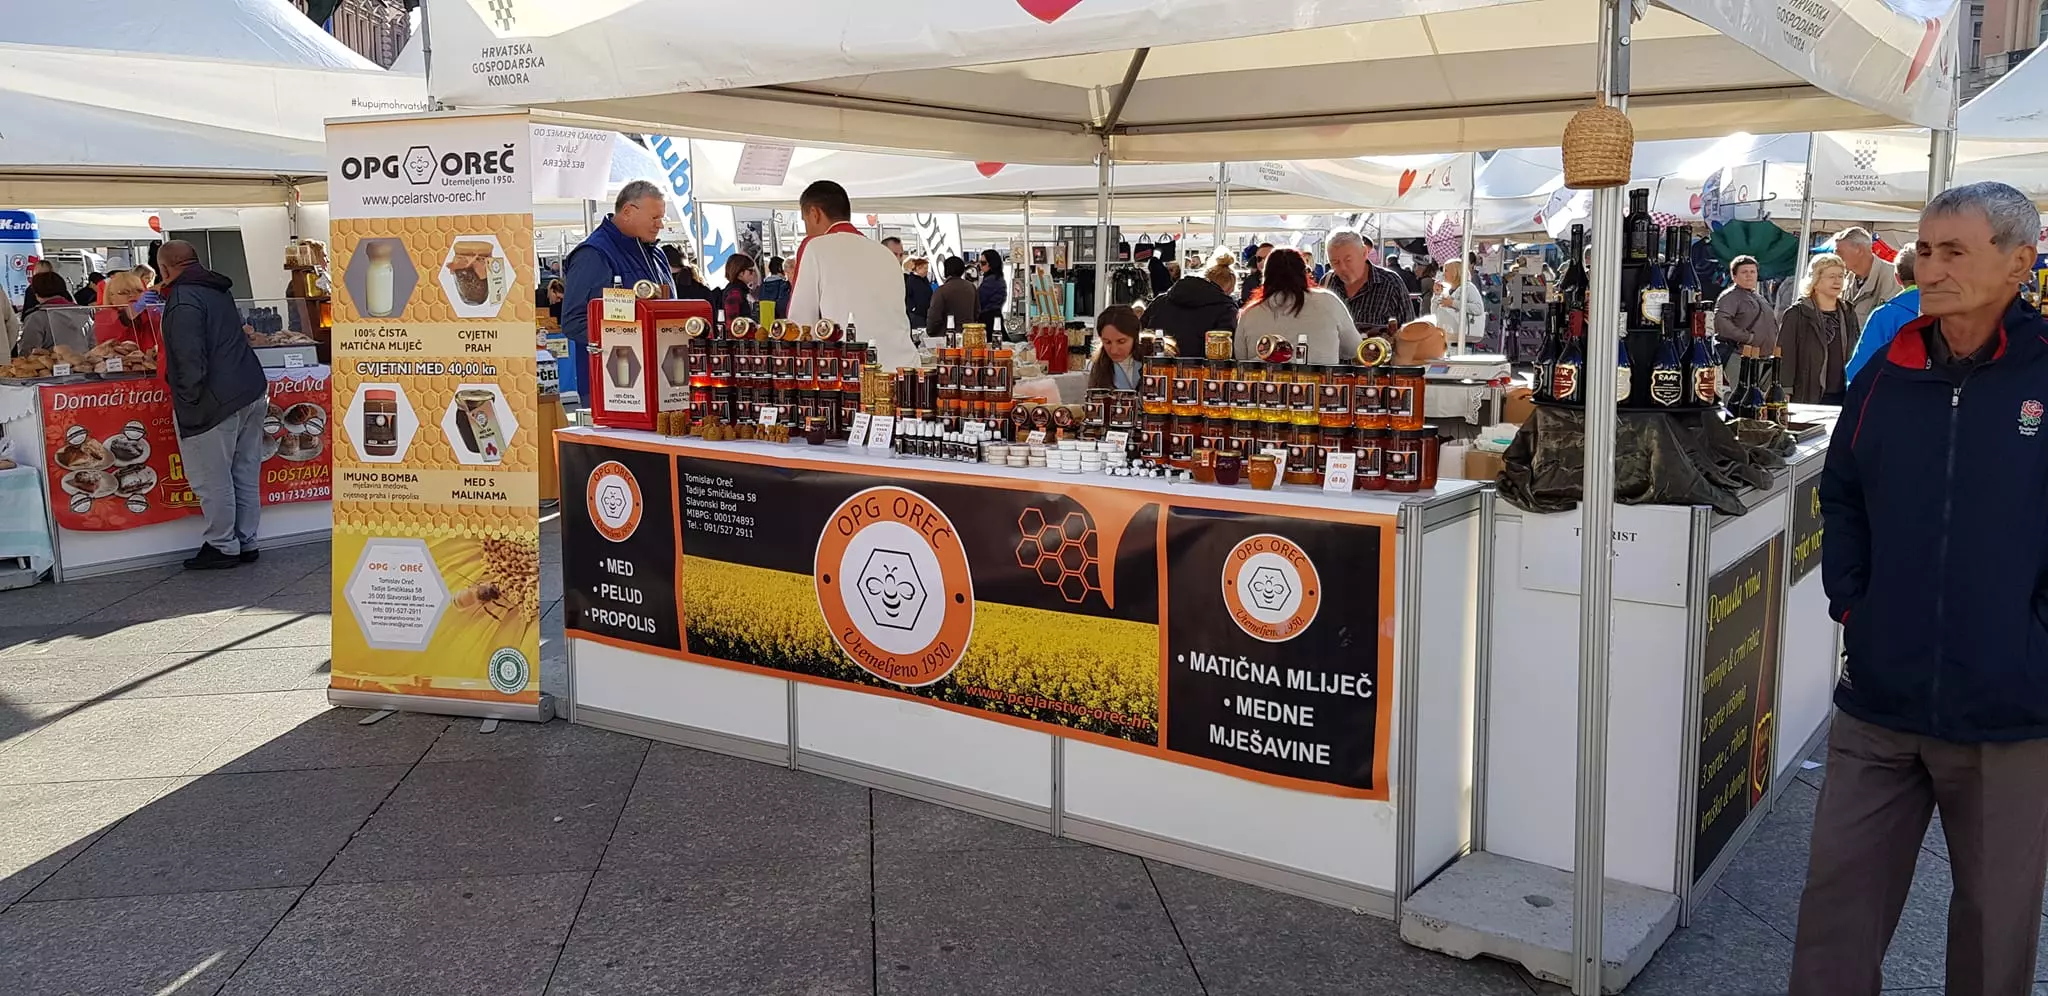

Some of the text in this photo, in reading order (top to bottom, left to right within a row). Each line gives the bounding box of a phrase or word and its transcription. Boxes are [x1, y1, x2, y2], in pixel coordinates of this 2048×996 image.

[1776, 6, 1825, 39] GOSPODARSKA
[481, 43, 533, 58] HRVATSKA
[472, 56, 545, 73] GOSPODARSKA
[488, 73, 530, 87] KOMORA
[341, 143, 515, 180] OPG OREČ
[441, 175, 515, 187] Utemeljeno 1950.
[362, 190, 487, 208] www.pcelarstvo-orec.hr
[353, 326, 408, 338] 100% ČISTA
[457, 330, 498, 341] CVJETNI
[340, 339, 423, 351] MATIČNA MLIJEČ
[464, 343, 492, 353] PRAH
[356, 361, 496, 377] CVJETNI MED 40,00 kn
[53, 388, 125, 411] Domaći
[152, 417, 170, 426] OPG
[267, 465, 329, 483] DOSTAVA
[343, 472, 419, 483] IMUNO BOMBA
[464, 477, 495, 487] MED S
[593, 465, 610, 482] OPG
[684, 473, 734, 487] Tomislav Oreč
[269, 486, 330, 502] 091 732 9280
[451, 490, 507, 501] MALINAMA
[684, 485, 757, 502] Tadije Smičiklasa 58
[686, 496, 737, 512] Slavonski Brod
[686, 508, 755, 527] MIBPG: 000174893
[837, 496, 953, 549] OPG OREČ
[686, 519, 754, 539] Tel.: 091/527 2911
[1236, 539, 1307, 569] OPG OREČ
[368, 562, 424, 573] OPG OREČ
[606, 557, 634, 576] MED
[601, 583, 643, 604] PELUD
[1707, 567, 1761, 644] Ponuda vina
[591, 607, 656, 634] PROPOLIS
[843, 627, 954, 679] Utemeljeno 1950.
[1190, 650, 1373, 699] MATIČNA MLIJEČ
[966, 685, 1150, 730] www.pcelarstvo-orec.hr
[1236, 695, 1315, 727] MEDNE
[1702, 717, 1708, 742] 2
[1209, 723, 1331, 765] MJEŠAVINE
[1701, 764, 1708, 789] 3
